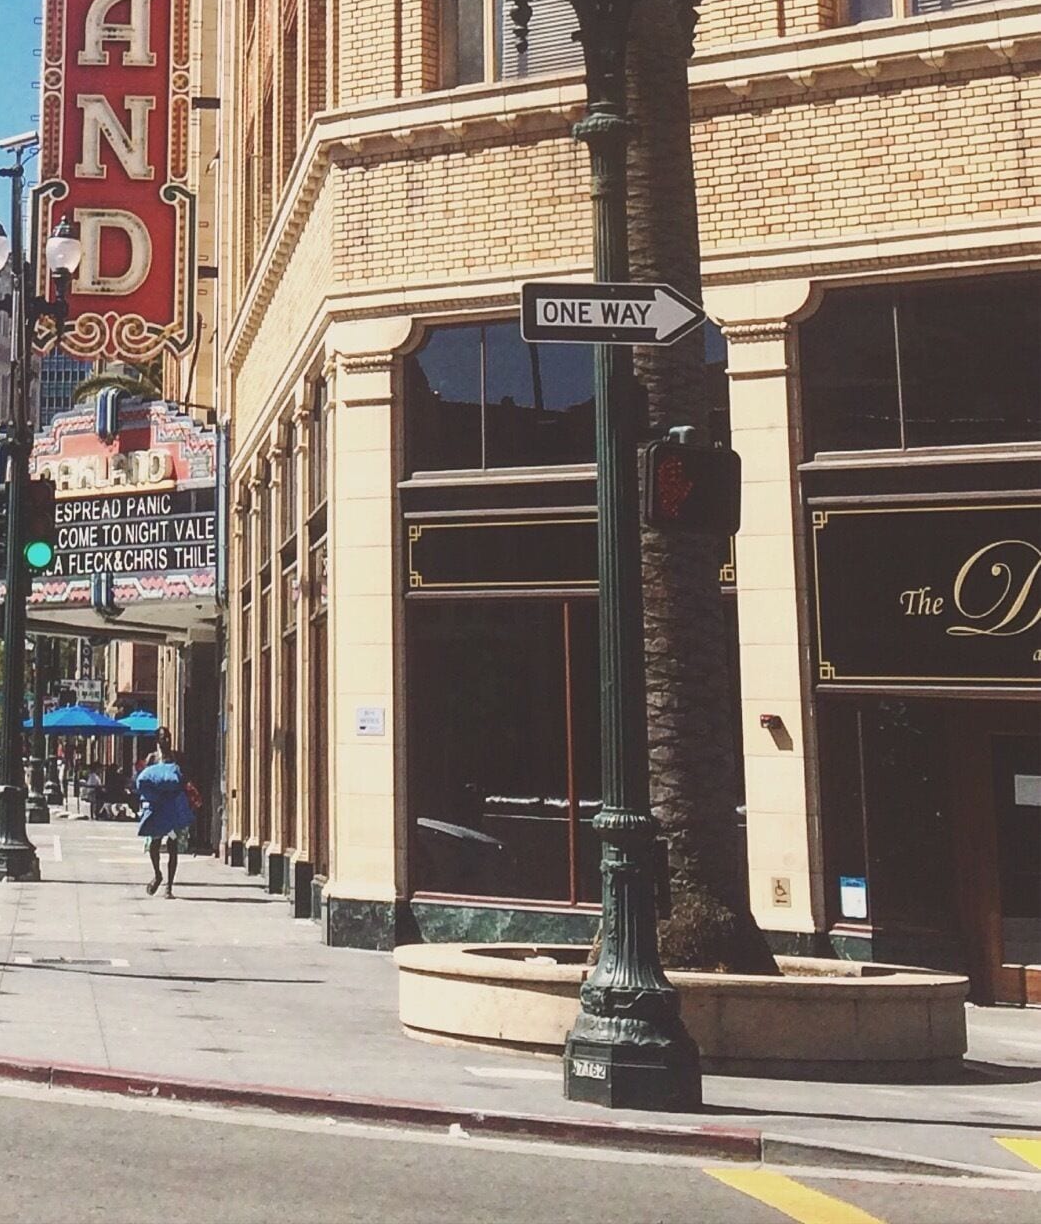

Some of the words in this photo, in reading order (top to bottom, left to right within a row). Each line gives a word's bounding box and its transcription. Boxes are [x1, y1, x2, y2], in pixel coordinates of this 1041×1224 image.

[543, 301, 592, 324] ONE
[600, 302, 652, 325] WAY
[127, 494, 172, 516] PANIC
[54, 526, 98, 549] COME
[102, 524, 122, 545] TO
[125, 520, 169, 543] NIGHT
[174, 517, 215, 541] VALE
[173, 545, 216, 568] THILE
[899, 586, 944, 616] The
